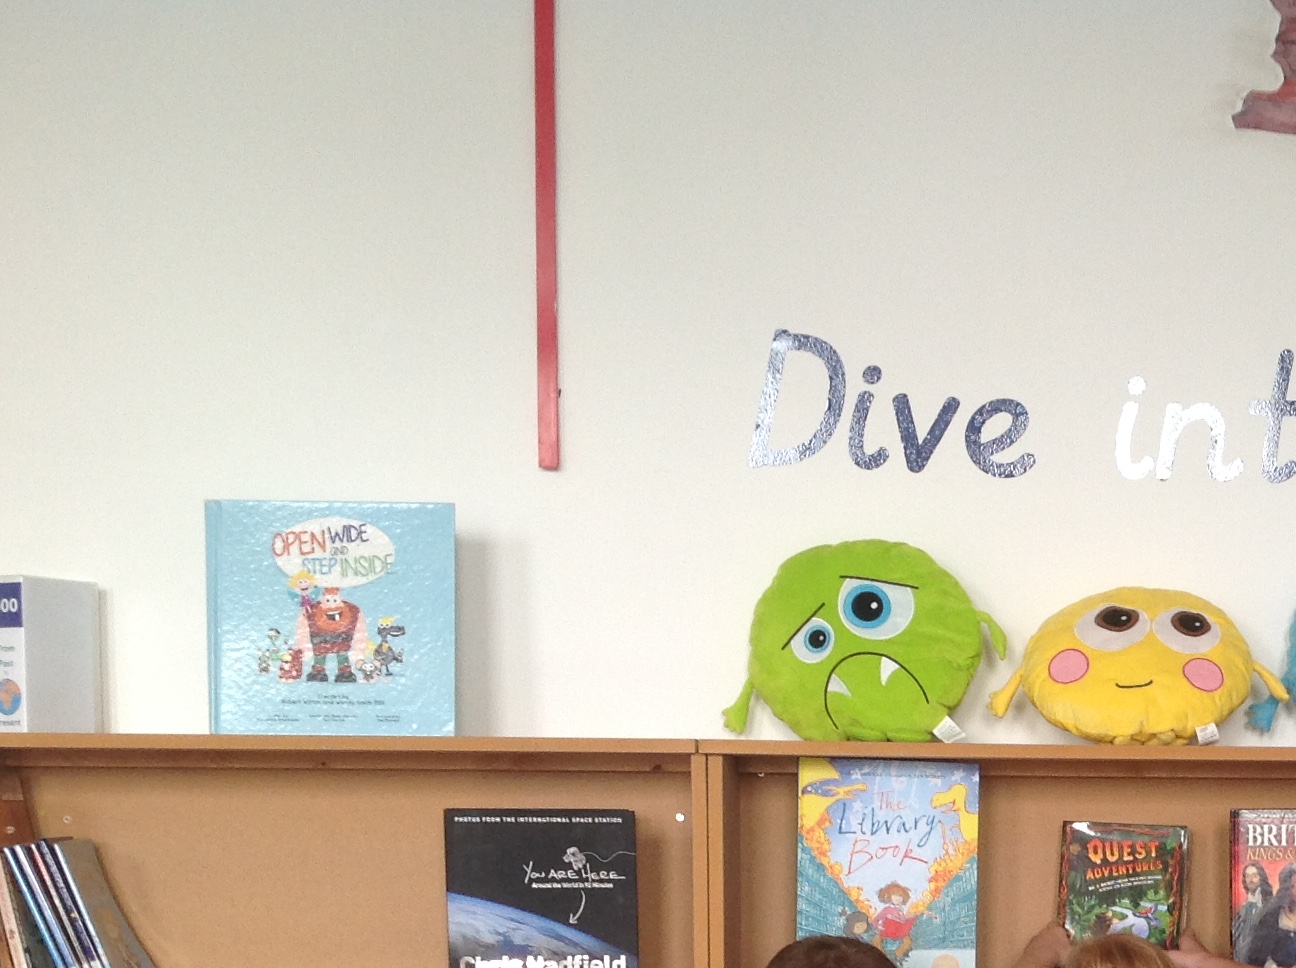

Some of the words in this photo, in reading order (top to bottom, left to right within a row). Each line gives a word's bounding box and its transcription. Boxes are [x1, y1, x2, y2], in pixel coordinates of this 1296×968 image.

[748, 328, 1036, 478] Dive
[271, 530, 327, 557] OPEN
[327, 524, 369, 545] WIDE
[302, 557, 338, 576] STEP
[340, 553, 396, 578] INSIDE
[878, 792, 906, 810] The
[838, 803, 941, 848] Library
[846, 838, 928, 876] Book
[1086, 837, 1160, 865] QUEST
[1246, 847, 1283, 861] KINGS
[1286, 847, 1296, 860] &
[548, 869, 579, 879] ARE
[1085, 861, 1164, 879] ADVENTURES
